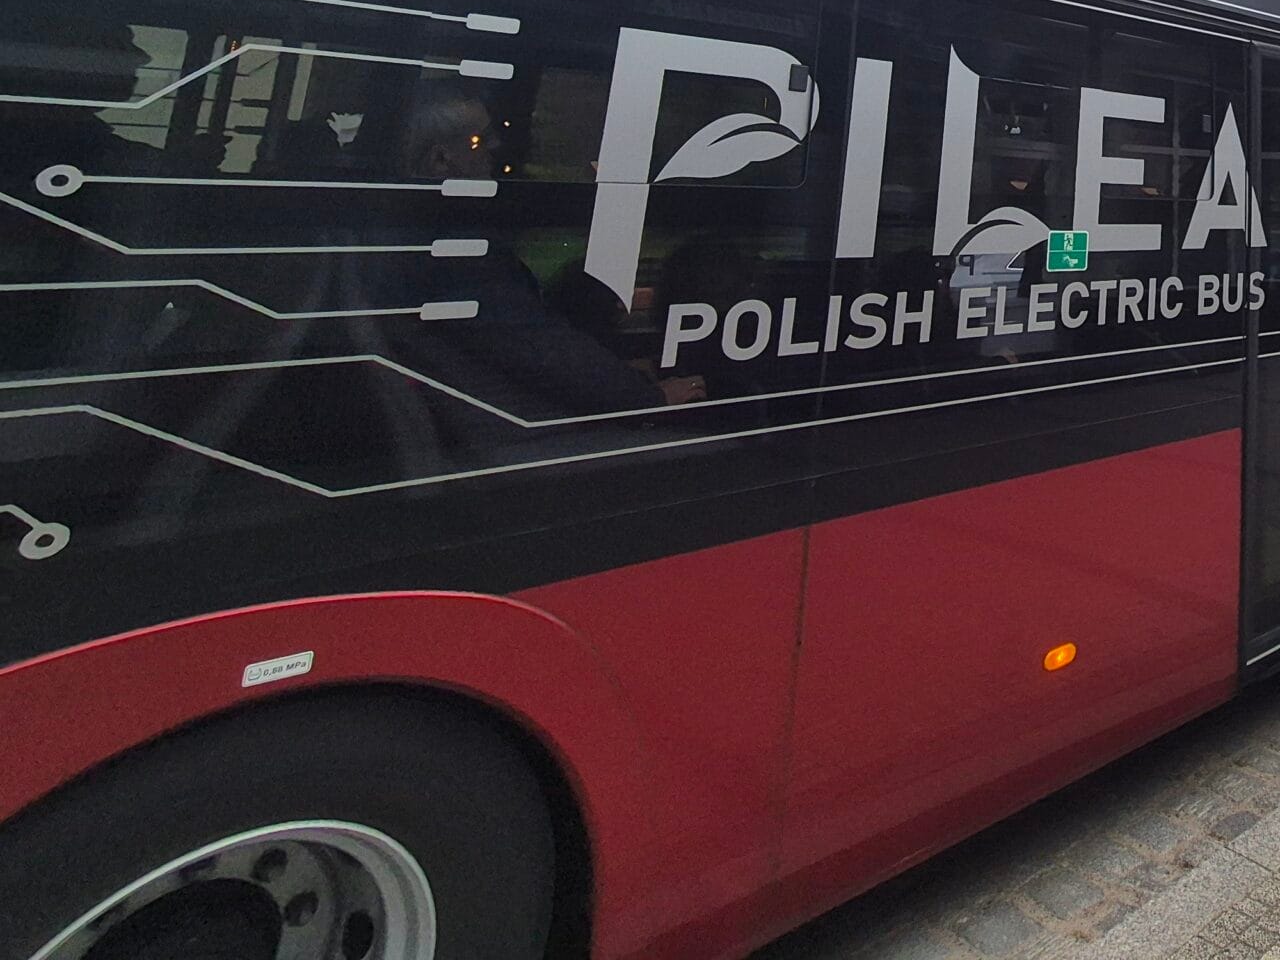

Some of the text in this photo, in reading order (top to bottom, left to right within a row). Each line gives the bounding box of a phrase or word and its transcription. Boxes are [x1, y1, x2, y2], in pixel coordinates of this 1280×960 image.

[584, 27, 1268, 314] PILEA
[660, 271, 1267, 368] POLISH ELECTRIC BUS
[286, 661, 307, 672] MPa
